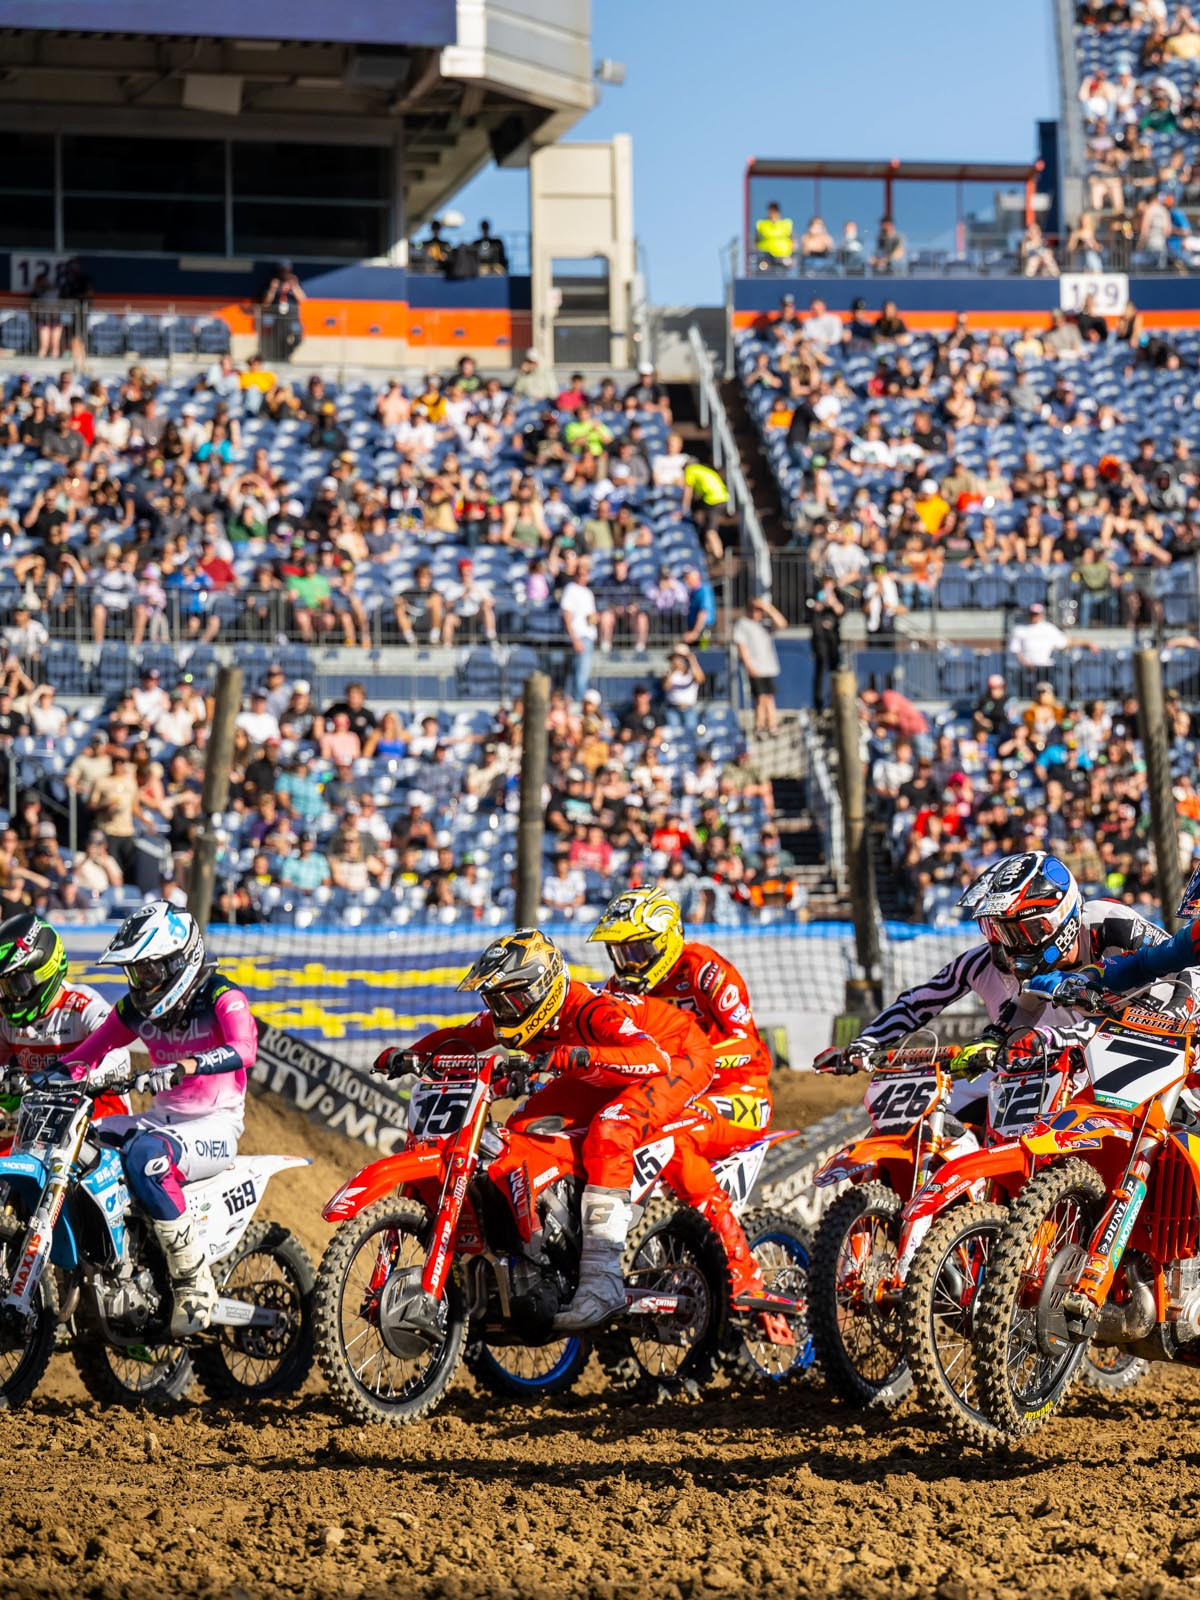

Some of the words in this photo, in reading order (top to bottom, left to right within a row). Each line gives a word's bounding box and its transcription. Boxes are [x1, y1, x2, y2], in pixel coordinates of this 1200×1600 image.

[1055, 918, 1076, 945] QUAD
[1060, 926, 1080, 952] LOCK
[1126, 1015, 1182, 1033] RENTHAL
[260, 1029, 327, 1079] ROCKY
[1093, 1038, 1180, 1094] 7
[414, 1093, 471, 1135] 15
[871, 1081, 937, 1121] 426
[993, 1083, 1050, 1128] 12
[1105, 1096, 1134, 1109] MOTOREX
[195, 1139, 229, 1158] ONEAL
[222, 1179, 256, 1215] 169
[1106, 1180, 1135, 1244] DUNLP
[1118, 1193, 1143, 1248] MOTOREX
[13, 1233, 41, 1297] MAXXIS
[431, 1221, 451, 1289] DUNLOP
